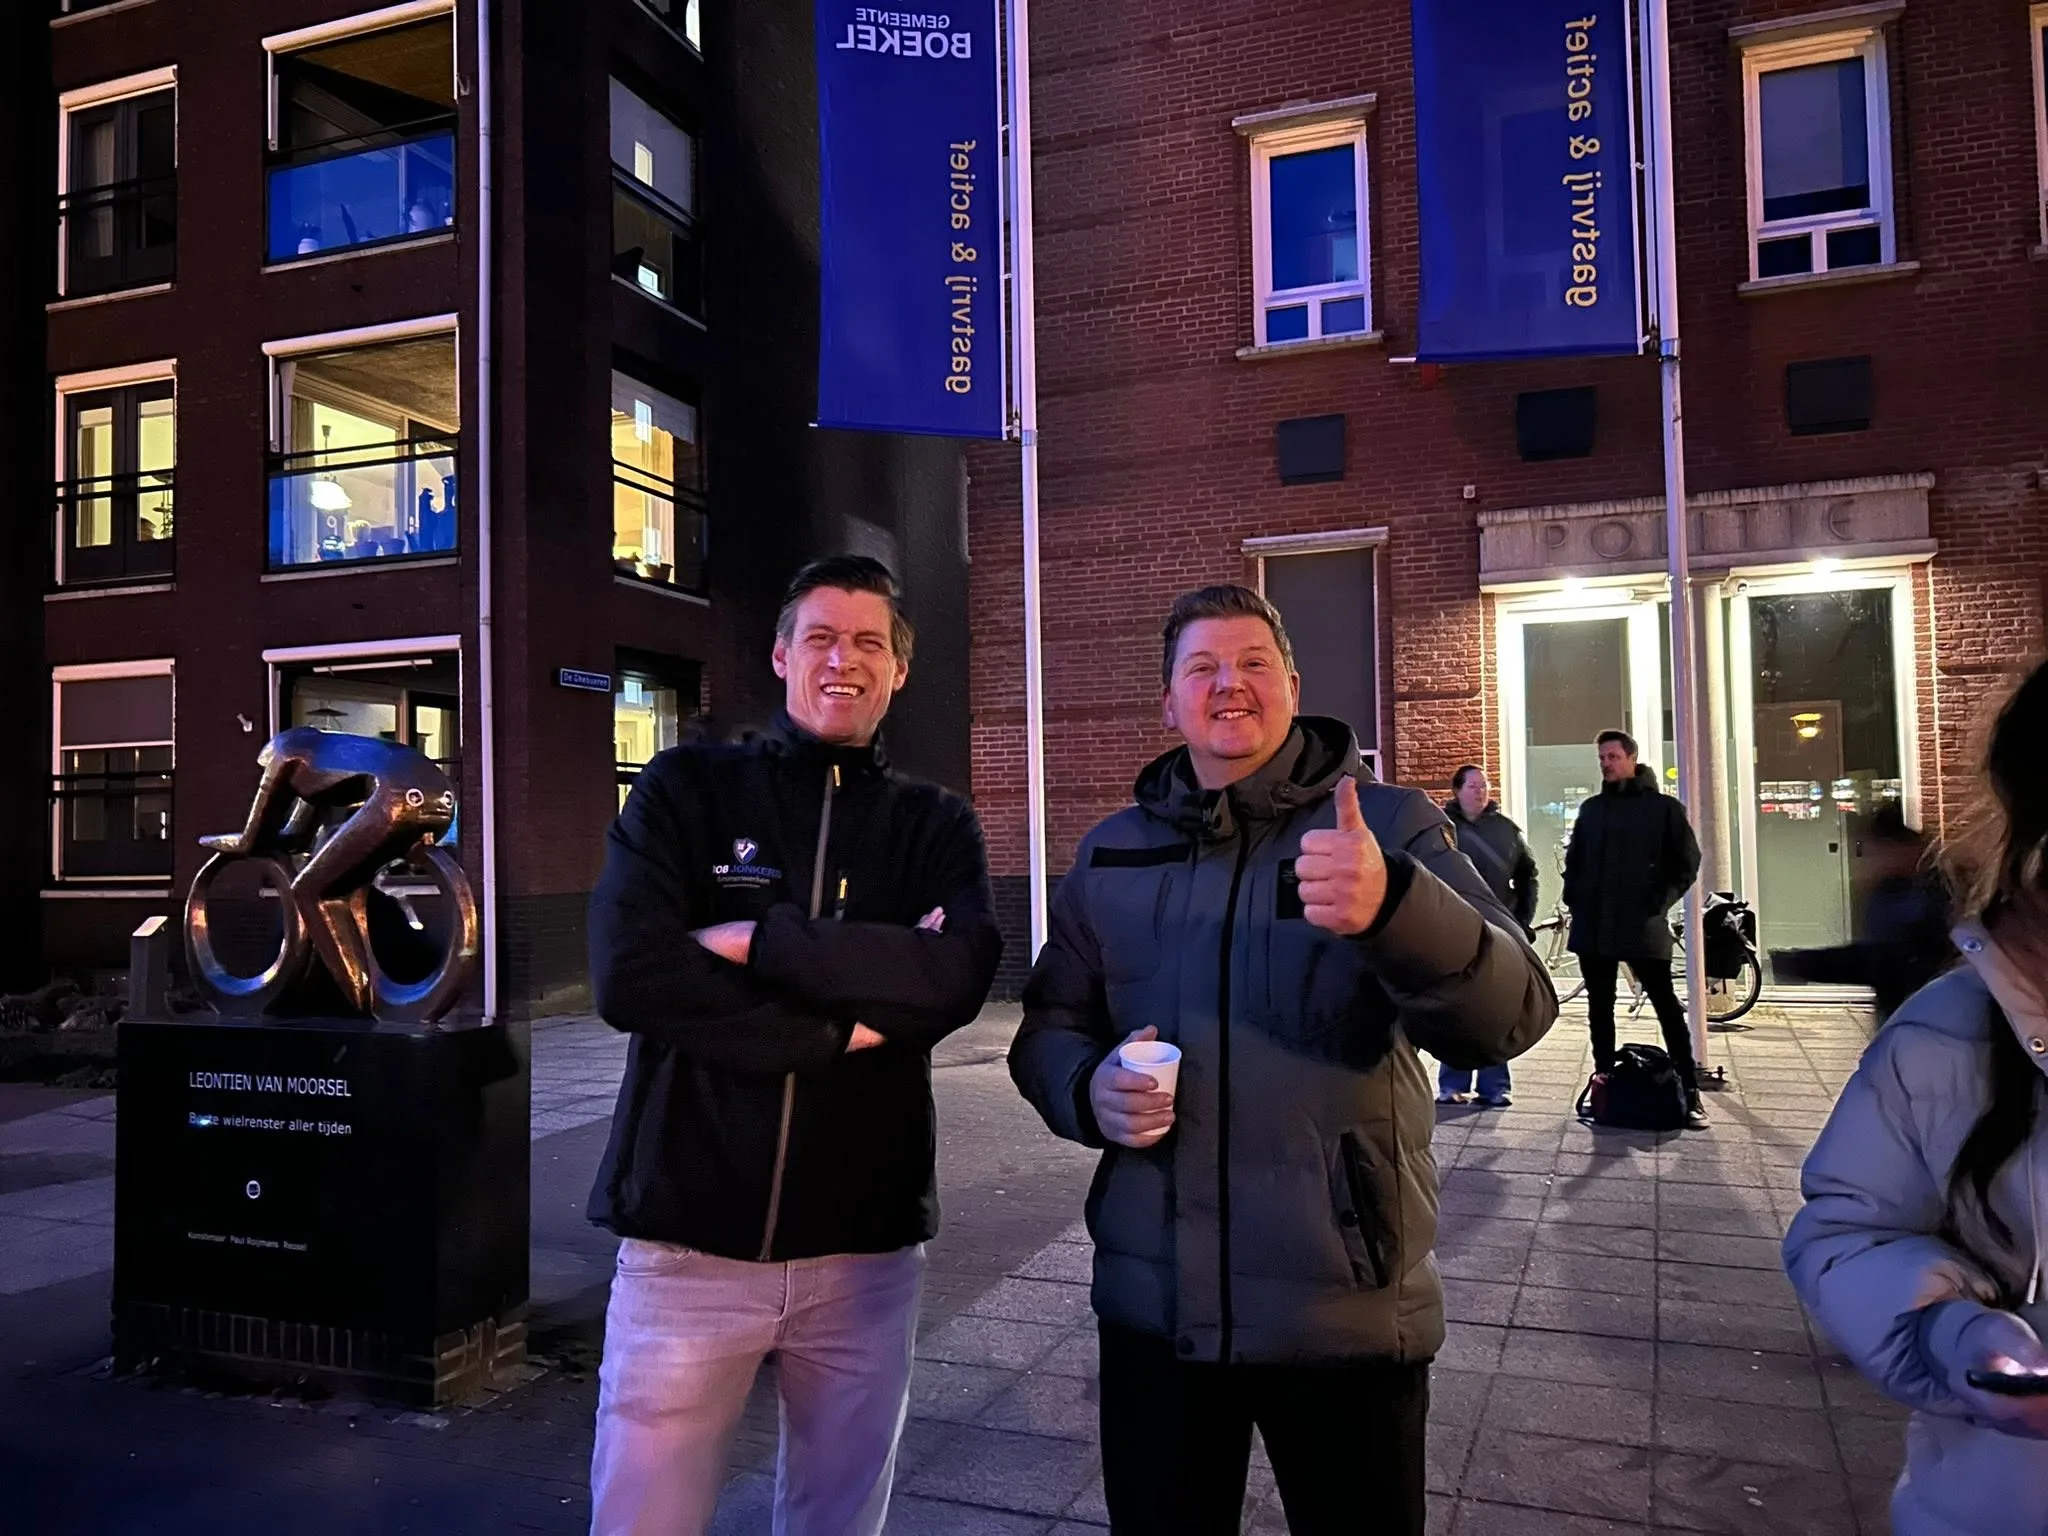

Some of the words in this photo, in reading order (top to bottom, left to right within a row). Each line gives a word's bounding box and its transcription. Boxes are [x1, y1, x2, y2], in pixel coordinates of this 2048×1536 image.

[189, 1072, 252, 1091] LEONTIEN
[256, 1075, 283, 1093] VAN
[287, 1077, 352, 1097] MOORSEL
[223, 1114, 285, 1130] wielrenster
[289, 1119, 314, 1132] aller
[318, 1121, 352, 1136] tijden
